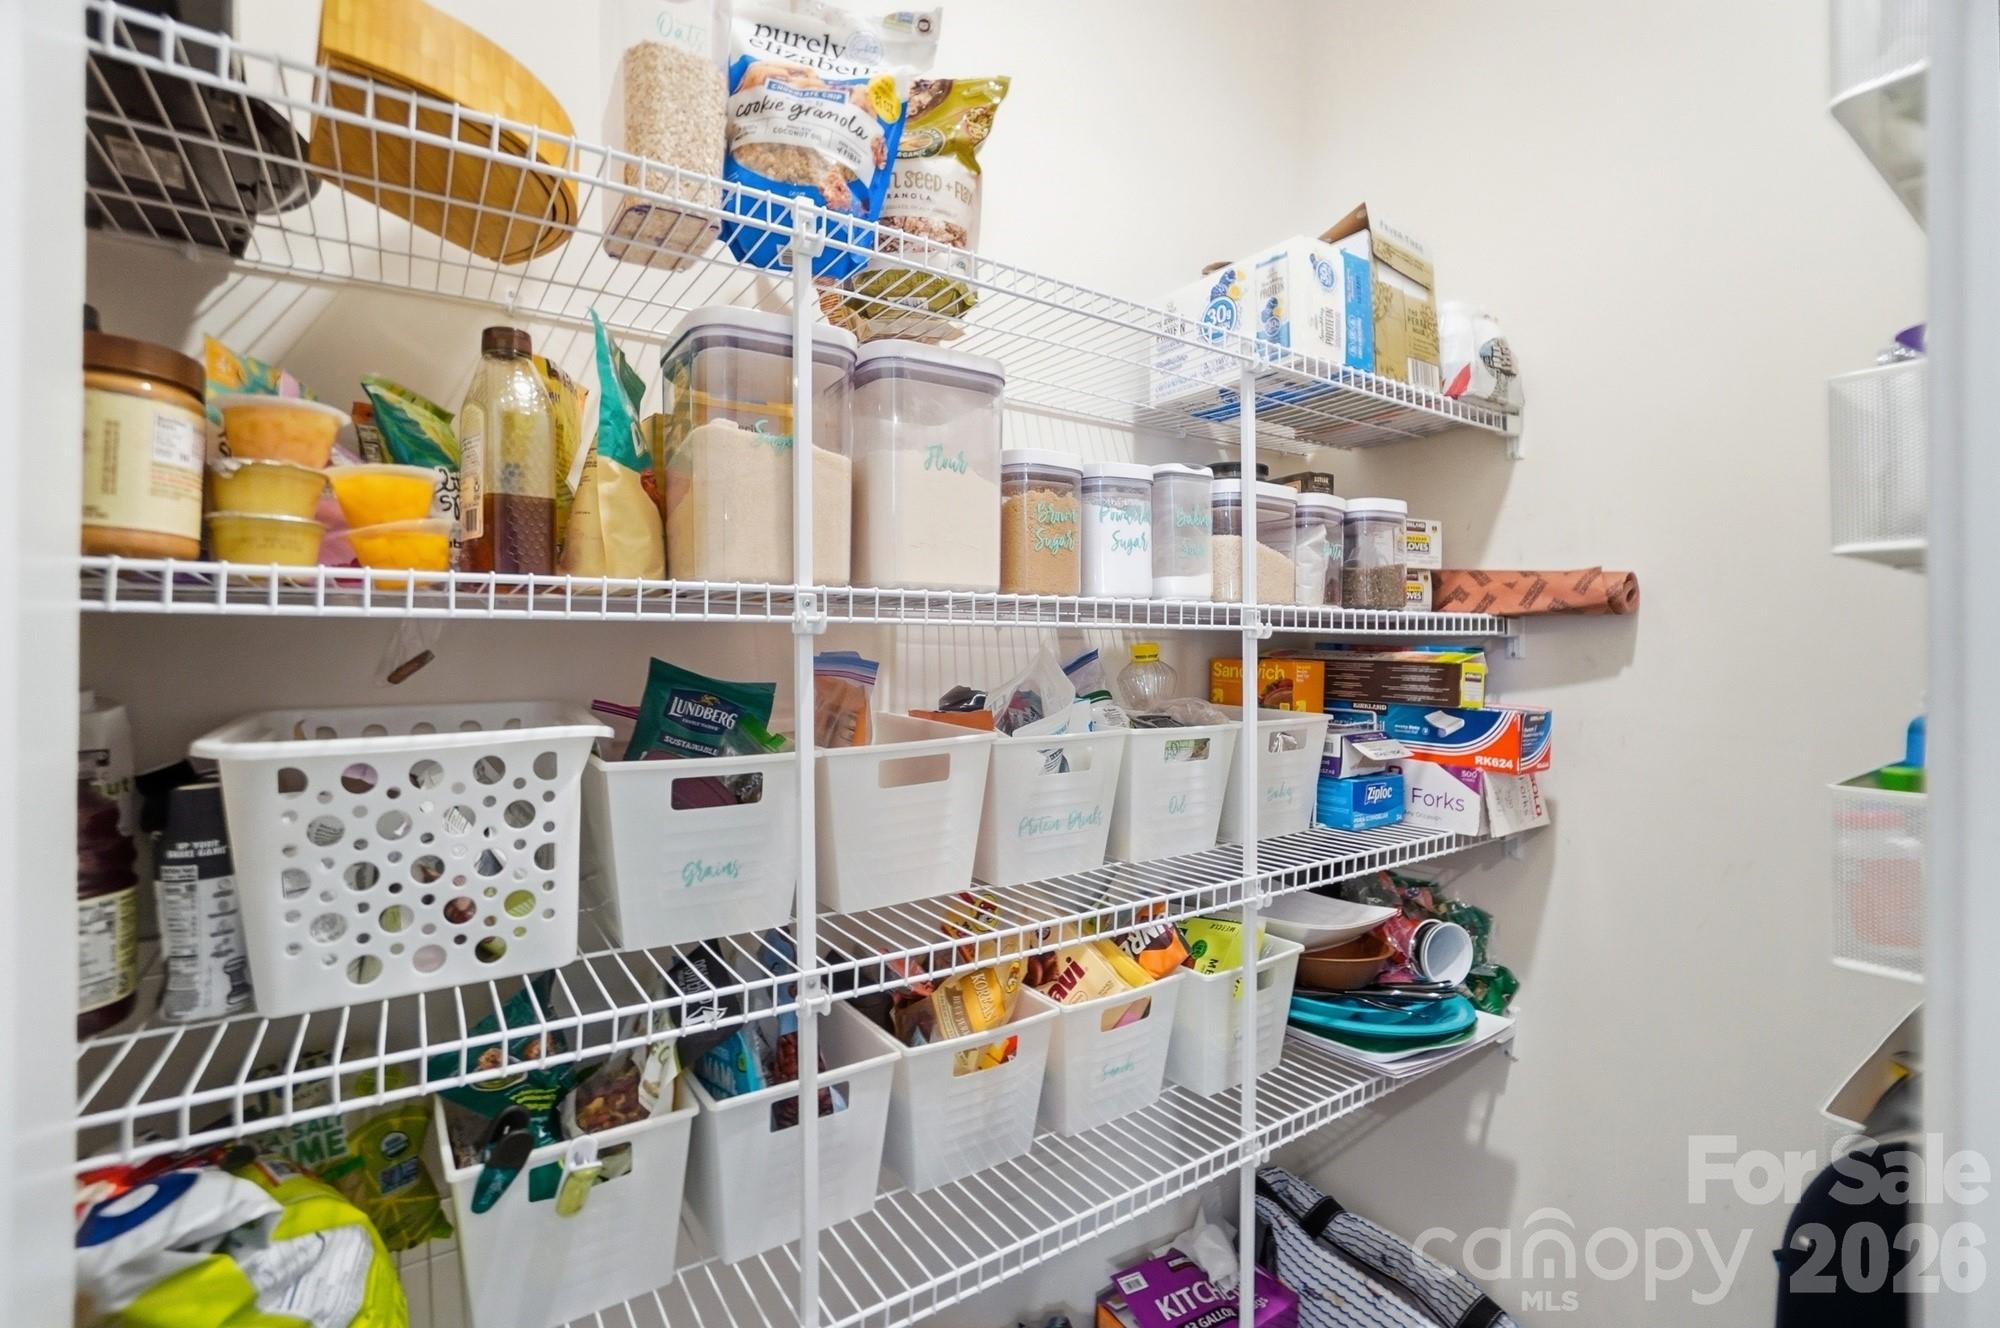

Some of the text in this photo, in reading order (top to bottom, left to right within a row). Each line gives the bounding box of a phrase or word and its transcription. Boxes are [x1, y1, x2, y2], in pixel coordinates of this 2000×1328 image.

[736, 96, 785, 118] cookie
[788, 101, 868, 141] granola
[886, 192, 932, 203] RANOLA
[923, 443, 968, 475] Flour
[1036, 502, 1077, 524] Brown
[1034, 528, 1074, 556] Sugar
[1111, 529, 1148, 556] Sugar
[1406, 542, 1430, 552] LOVES
[667, 696, 739, 731] LUNDBERG
[663, 734, 720, 757] SUSTAINABLE
[1474, 755, 1514, 769] RK624
[1367, 785, 1393, 803] Ziploc
[1411, 787, 1465, 813] Forks
[681, 859, 740, 887] Grains
[970, 972, 995, 1023] KOREAN
